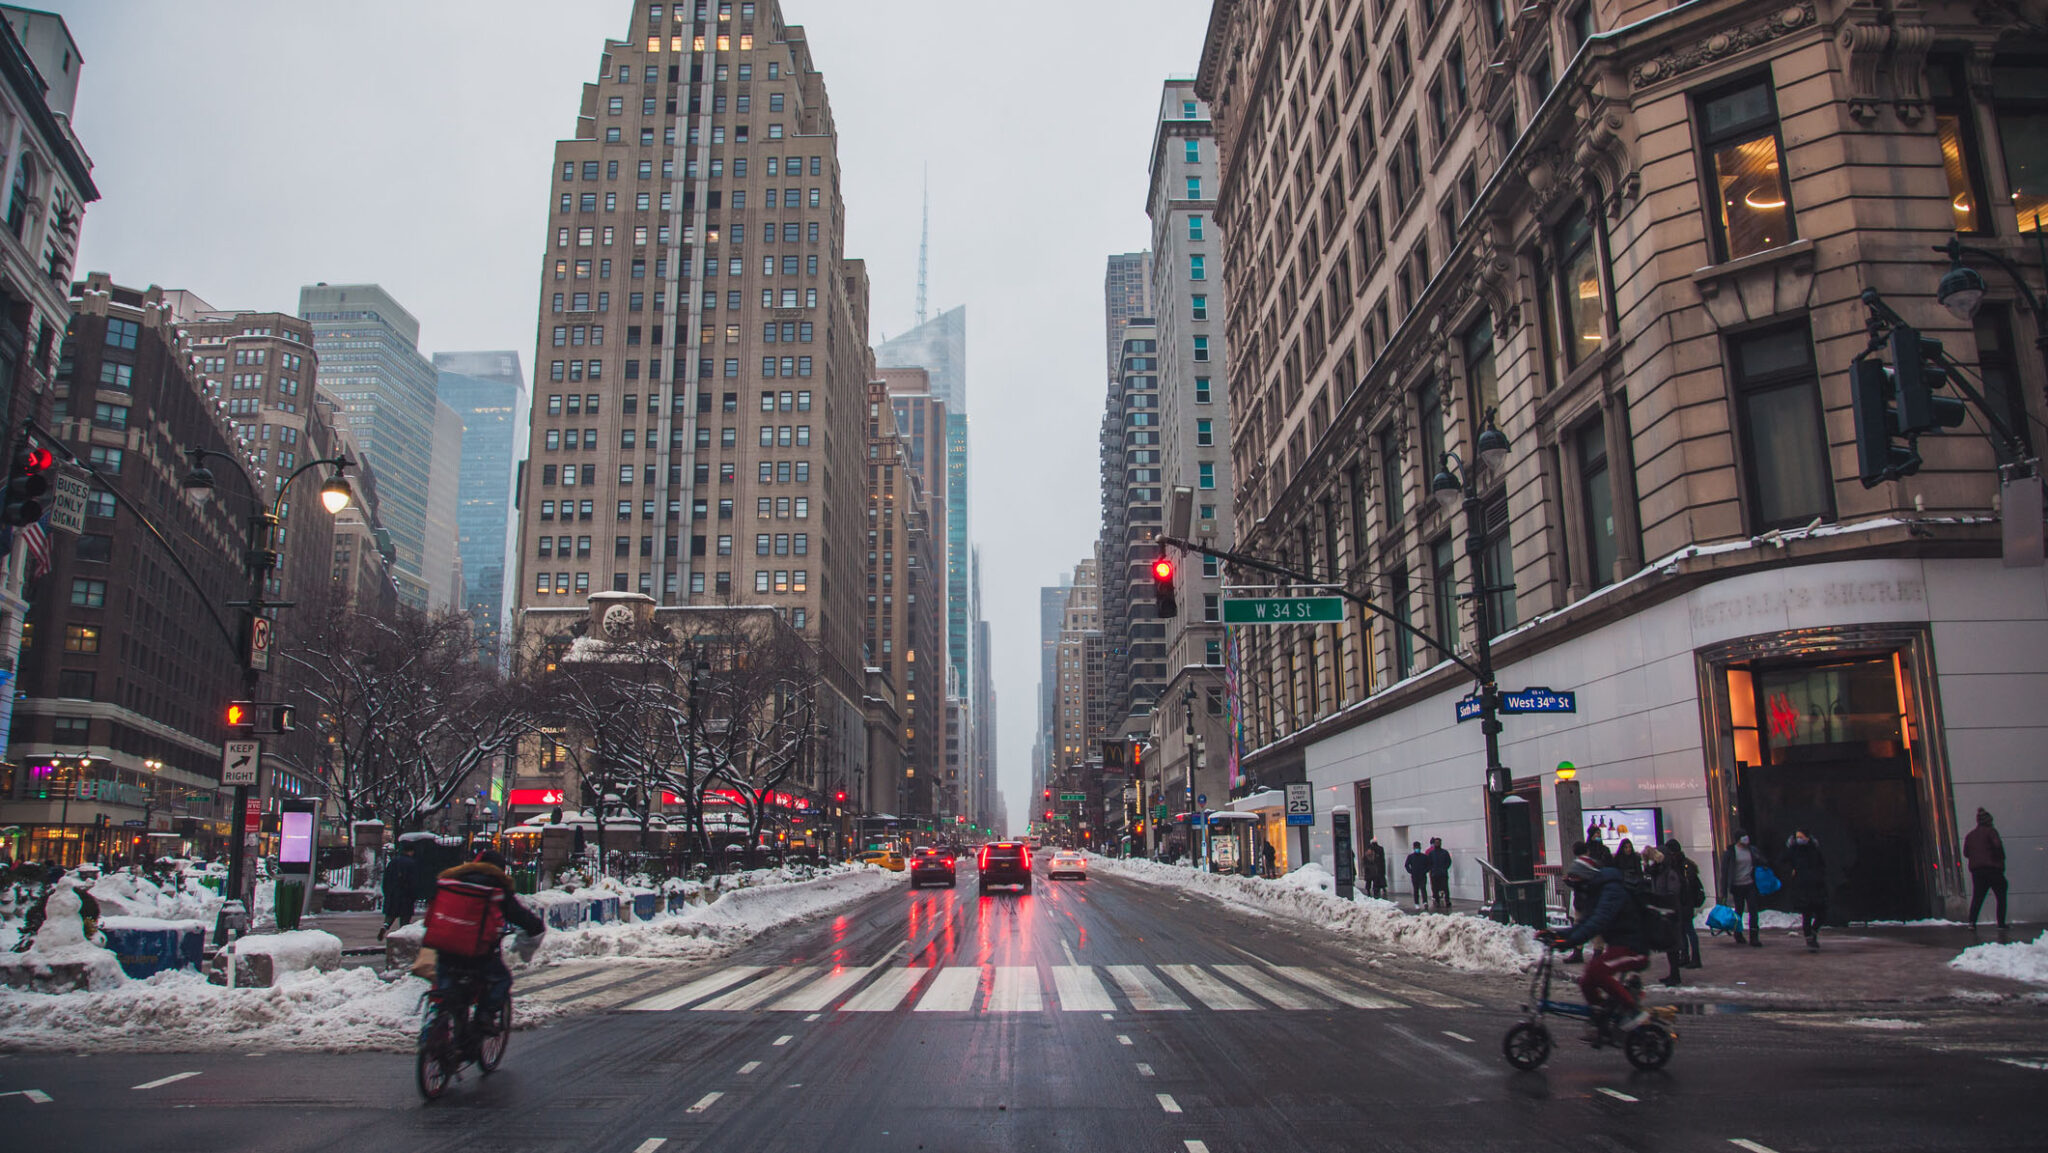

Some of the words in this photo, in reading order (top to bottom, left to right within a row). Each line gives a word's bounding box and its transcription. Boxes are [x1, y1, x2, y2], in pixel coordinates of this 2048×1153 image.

[57, 478, 88, 499] BUSES
[57, 495, 83, 513] ONLY
[53, 509, 82, 530] SIGNAL
[1255, 603, 1266, 618] W
[1272, 603, 1290, 618] 34
[1297, 603, 1311, 617] St
[1460, 704, 1471, 717] Sixth
[1472, 702, 1480, 713] Ave
[1508, 697, 1535, 708] West
[1537, 696, 1556, 708] 34th
[1558, 697, 1569, 708] St
[230, 744, 255, 752] KEEP
[225, 772, 254, 780] RIGHT
[1290, 801, 1309, 812] 25
